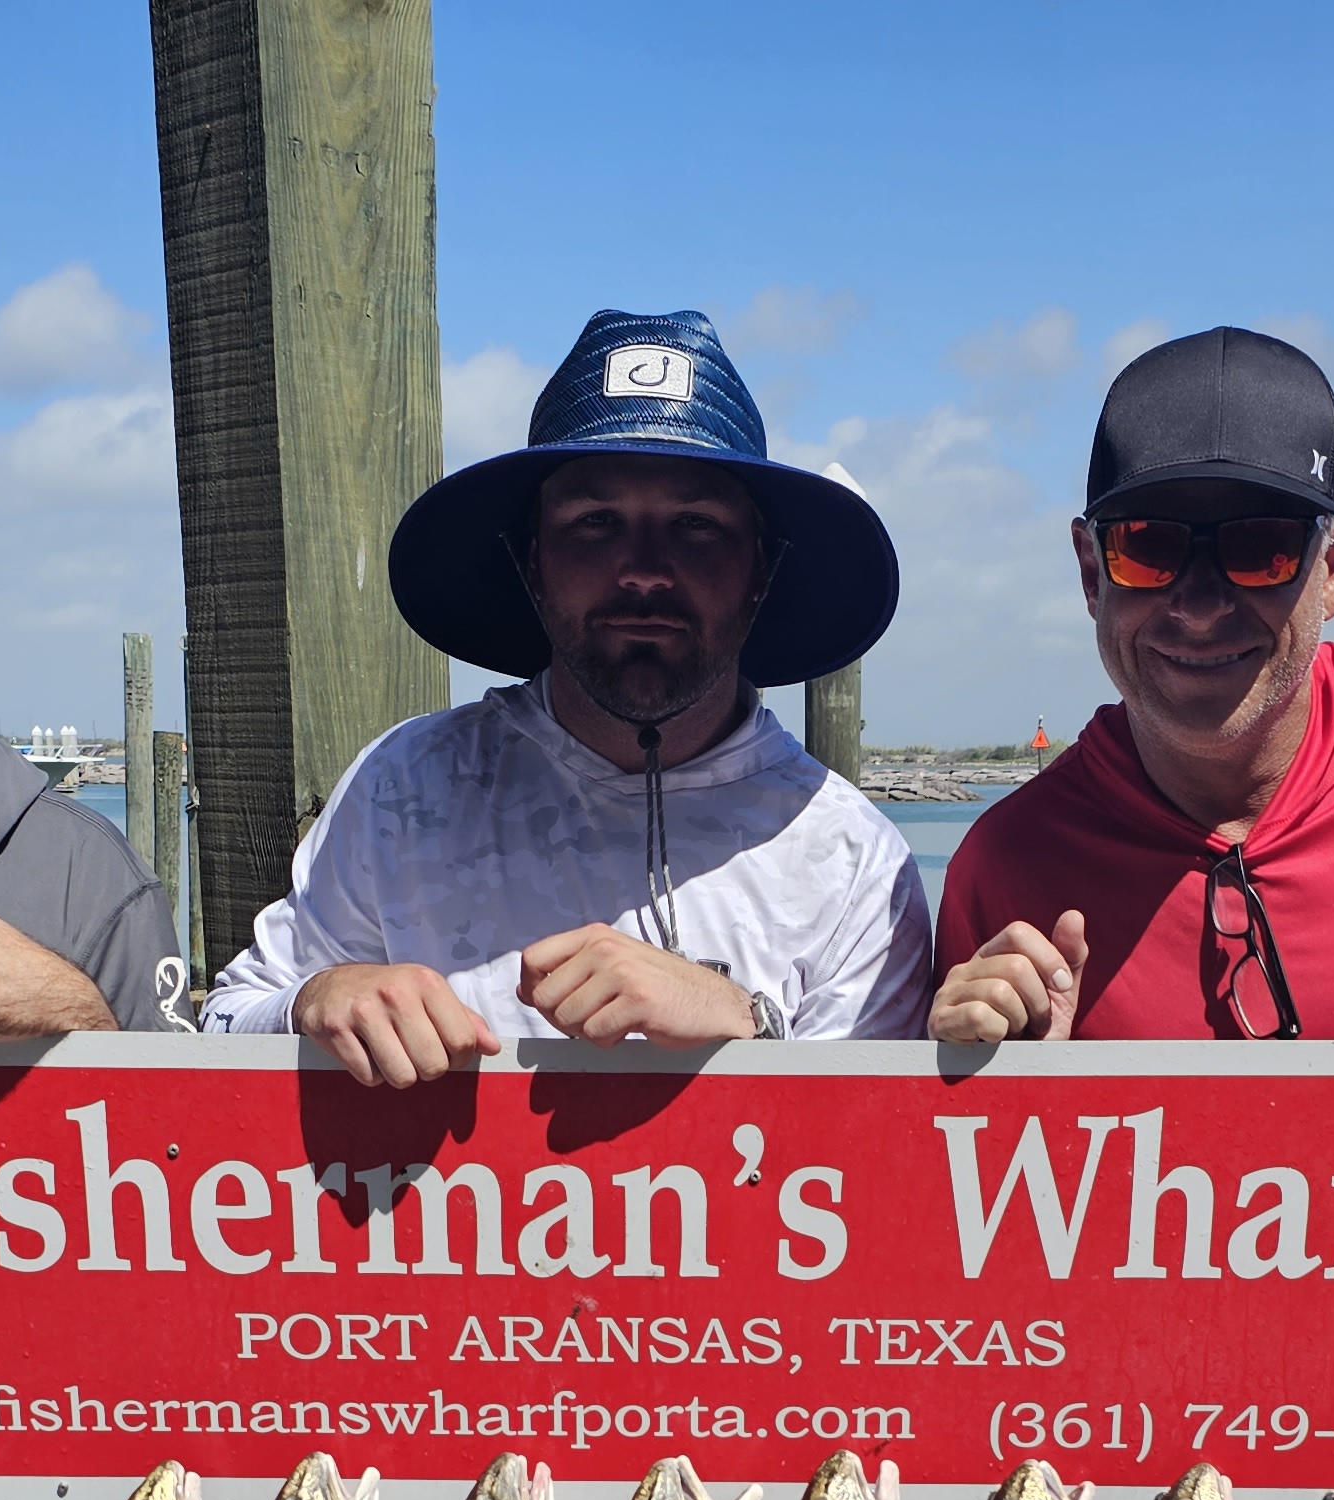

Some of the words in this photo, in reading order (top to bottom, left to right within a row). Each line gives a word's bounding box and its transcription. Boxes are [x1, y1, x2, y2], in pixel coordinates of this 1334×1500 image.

[234, 1312, 429, 1361] PORT
[448, 1315, 803, 1375] ARANSAS,
[827, 1317, 1066, 1367] TEXAS
[989, 1401, 1155, 1463] (361)
